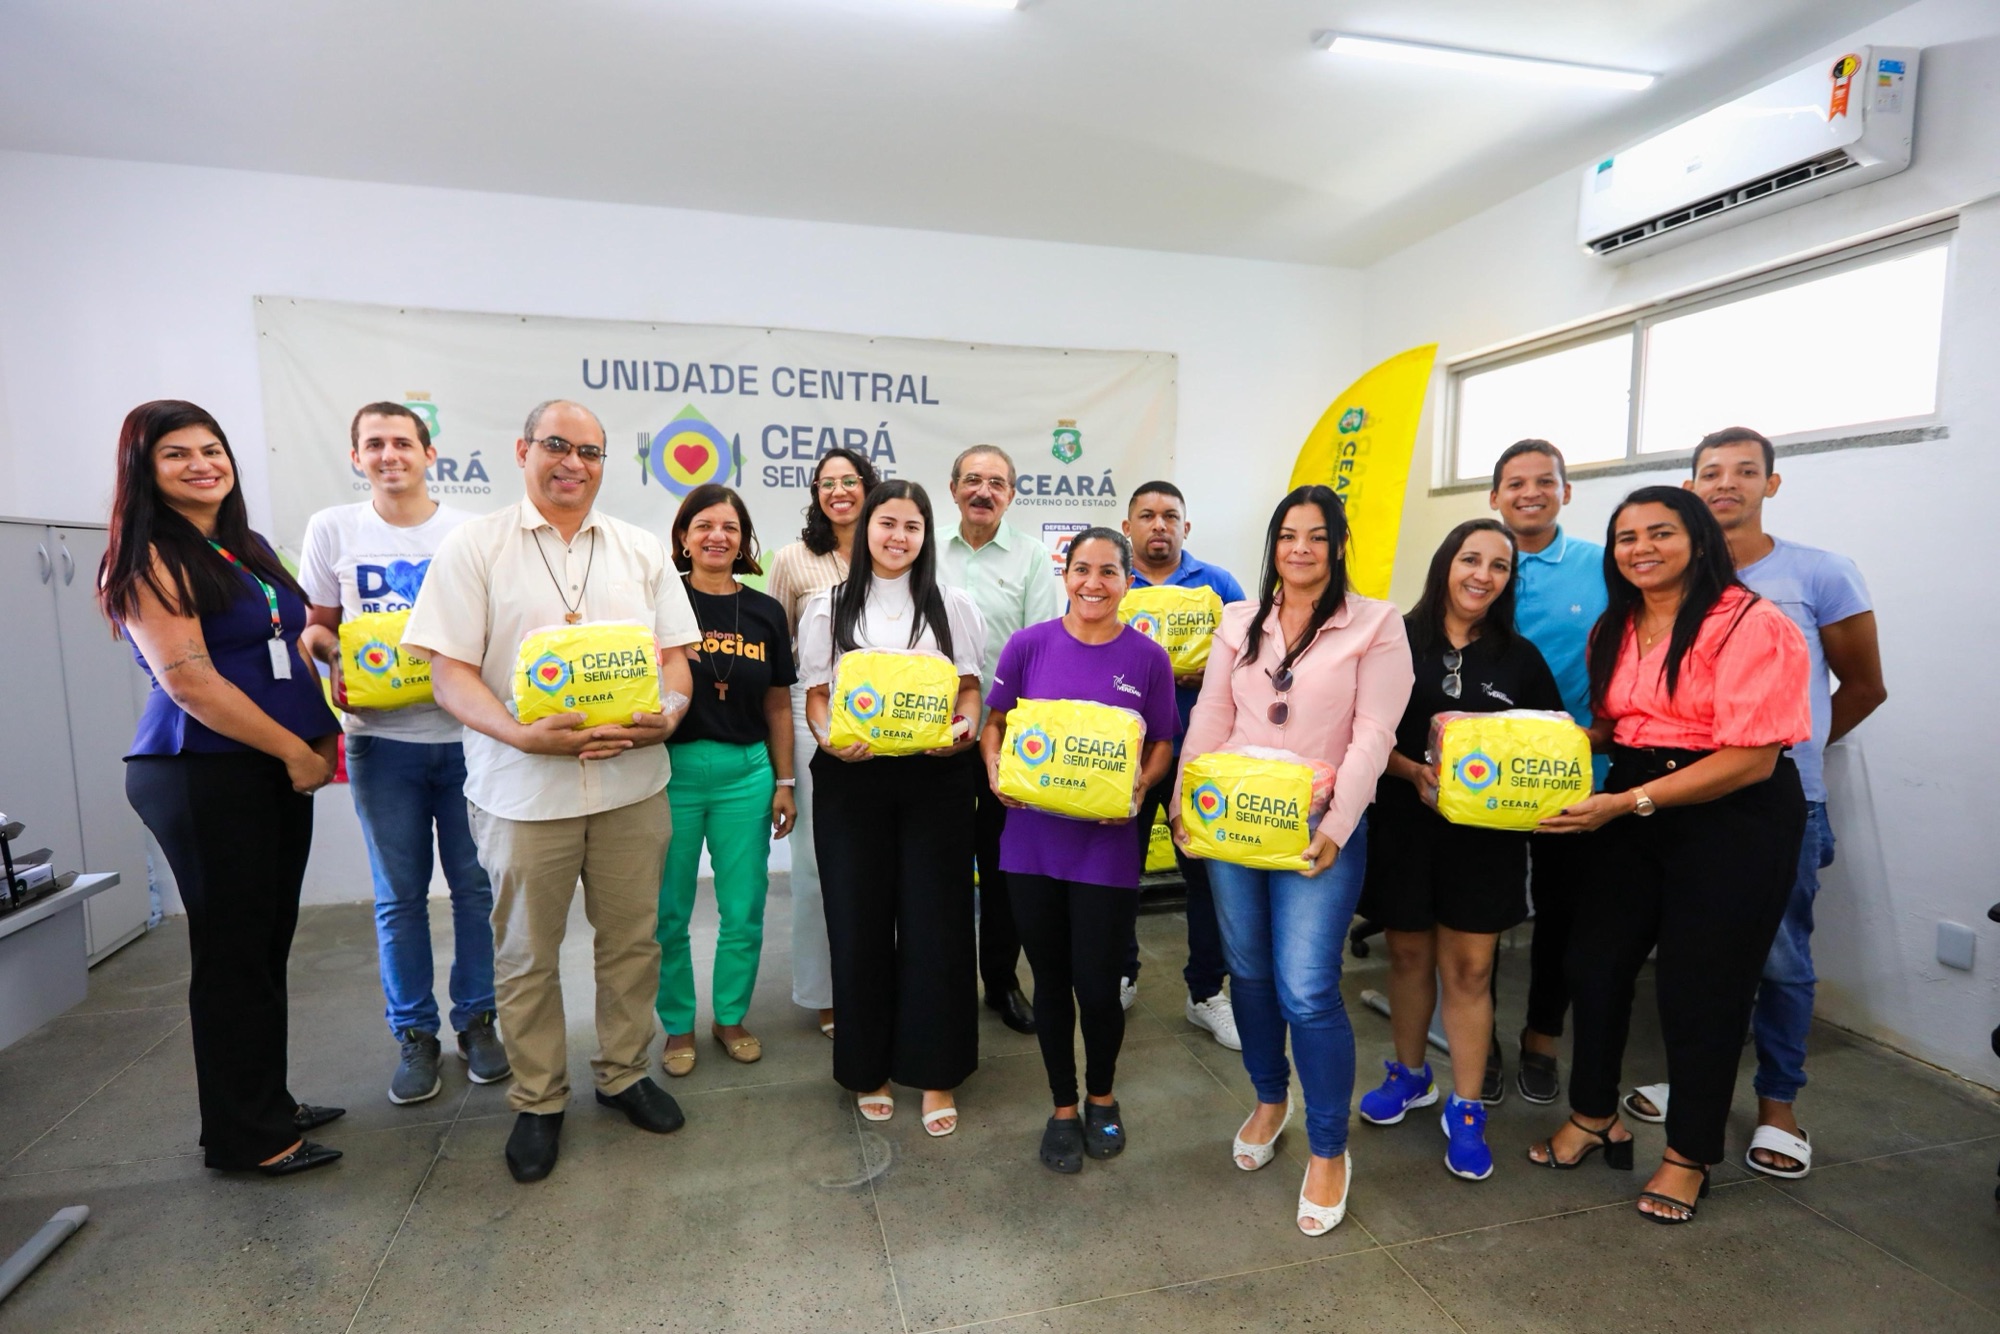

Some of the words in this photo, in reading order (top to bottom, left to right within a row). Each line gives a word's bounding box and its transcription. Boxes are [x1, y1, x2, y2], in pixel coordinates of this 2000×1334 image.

[582, 358, 759, 396] UNIDADE
[772, 366, 940, 405] CENTRAL
[761, 421, 897, 464] CEARÁ
[444, 485, 491, 495] ESTADO
[1016, 468, 1117, 497] CEARÁ
[1015, 498, 1062, 507] GOVERNO
[1065, 499, 1079, 507] DO
[1082, 499, 1117, 507] ESTADO
[362, 603, 380, 613] DE
[1166, 609, 1216, 626] CEARÁ
[1167, 626, 1188, 636] SEM
[408, 656, 430, 666] SE
[582, 646, 647, 670] CEARÁ
[404, 675, 432, 685] CEAR
[584, 670, 612, 683] SEM
[614, 666, 648, 680] FOME
[578, 691, 614, 703] CEARÁ
[893, 692, 949, 713] CEARÁ
[891, 708, 915, 721] SEM
[918, 711, 947, 725] FOME
[883, 729, 913, 739] CEARÁ
[1064, 735, 1127, 760] CEARÁ
[1063, 753, 1089, 768] SEM
[1092, 759, 1127, 773] FOME
[1511, 757, 1582, 778] CEARÁ
[1053, 777, 1087, 788] CEARÁ
[1510, 776, 1540, 789] SEM
[1543, 777, 1582, 791] FOME
[1236, 792, 1299, 819] CEARÁ
[1501, 799, 1539, 809] CEARÁ
[1235, 810, 1262, 826] SEM
[1264, 816, 1299, 831] FOME
[1229, 832, 1262, 845] CEARÁ
